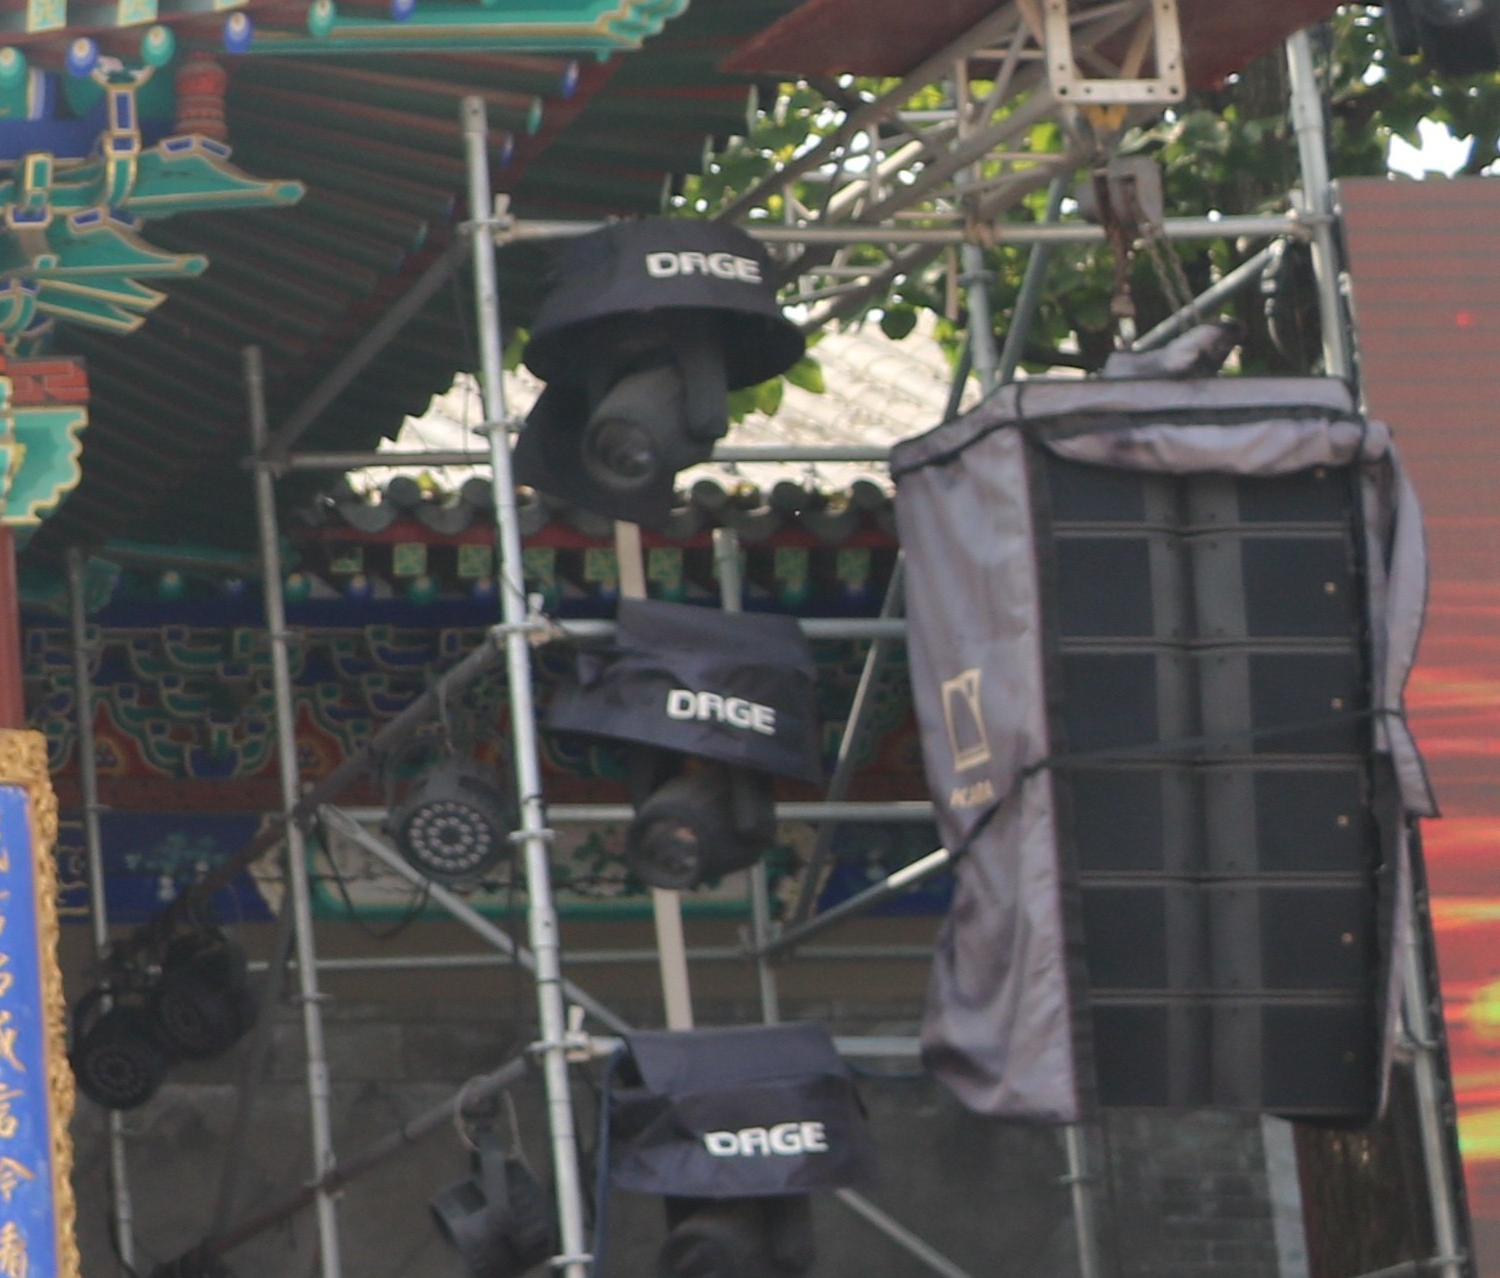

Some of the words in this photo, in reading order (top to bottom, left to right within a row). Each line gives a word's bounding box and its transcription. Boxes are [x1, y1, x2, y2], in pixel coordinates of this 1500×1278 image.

[646, 251, 764, 284] DAGE
[666, 688, 777, 737] DAGE
[703, 1121, 829, 1157] DAGE
